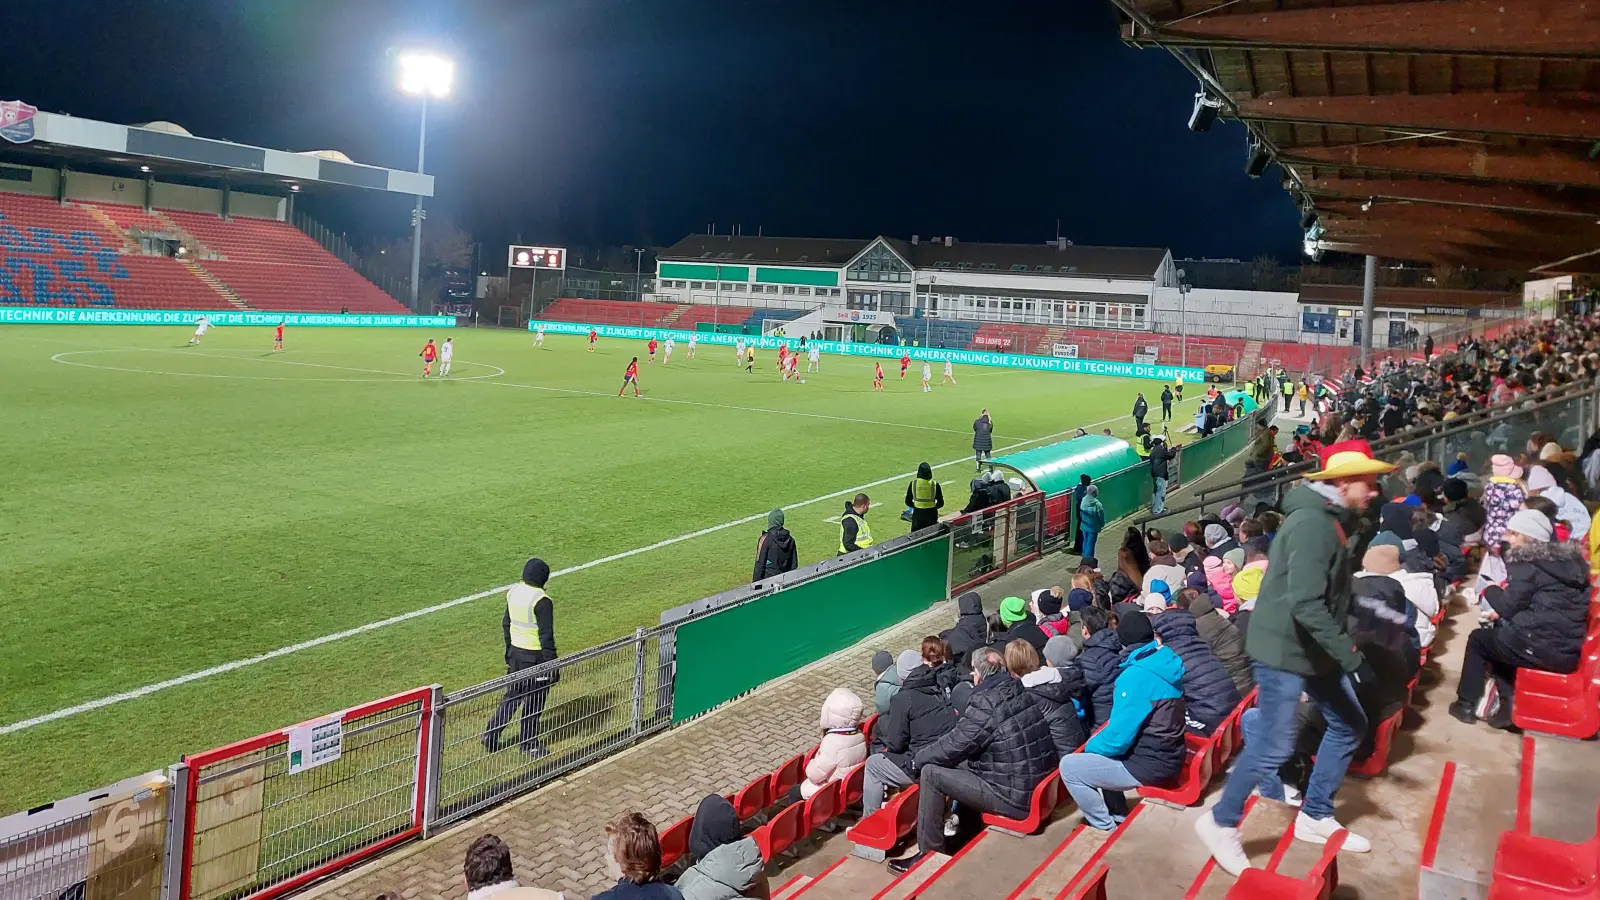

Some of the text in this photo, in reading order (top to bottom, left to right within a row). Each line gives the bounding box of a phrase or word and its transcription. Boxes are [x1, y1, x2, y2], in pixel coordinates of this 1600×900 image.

[0, 310, 54, 321] TECHNIK
[56, 311, 76, 321] DIE
[78, 311, 161, 323] ANERKENNUNG
[163, 312, 181, 323] DIE
[228, 314, 243, 324] DIE
[245, 314, 285, 325] TECHNIK
[285, 314, 300, 325] DIE
[300, 315, 359, 326] ANERKENNUNG
[360, 316, 373, 326] DIE
[406, 317, 418, 327] DIE
[605, 327, 643, 339] ZUKUNFT
[643, 329, 657, 339] DIE
[696, 332, 709, 343] DIE
[852, 344, 895, 357] TECHNIK
[912, 349, 990, 364] ANERKENNUNG
[991, 355, 1009, 366] DIE
[1011, 356, 1061, 369] ZUKUNFT
[1063, 360, 1081, 371] DIE
[1083, 361, 1133, 375] TECHNIK
[1135, 364, 1155, 377] DIE
[1156, 367, 1205, 381] ANERKE
[104, 798, 140, 853] 6
